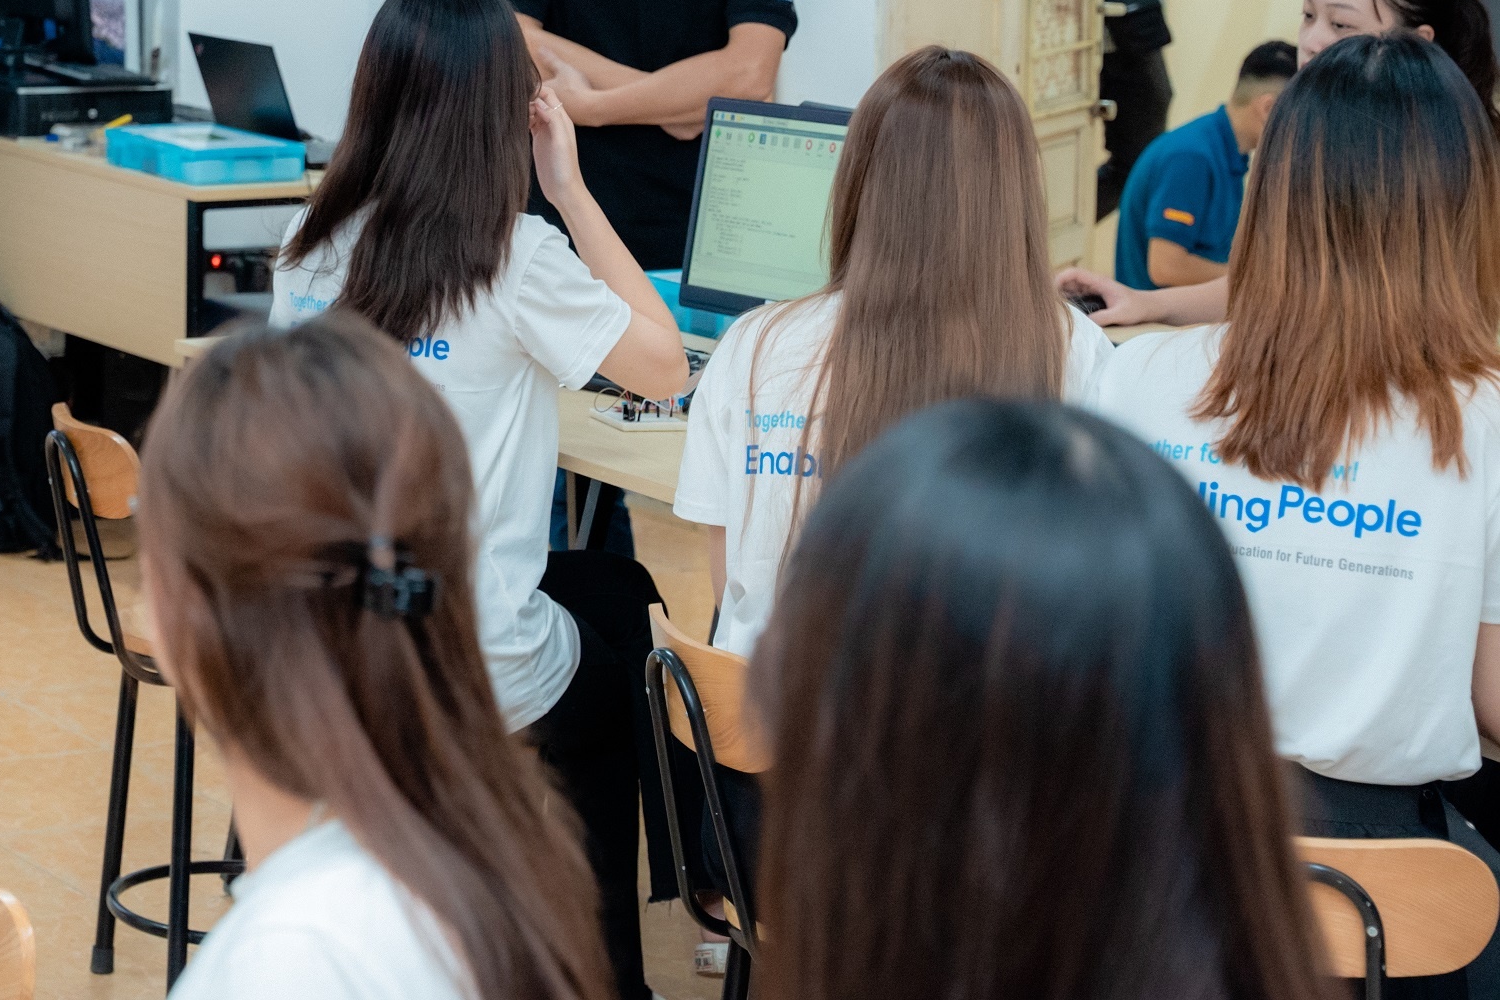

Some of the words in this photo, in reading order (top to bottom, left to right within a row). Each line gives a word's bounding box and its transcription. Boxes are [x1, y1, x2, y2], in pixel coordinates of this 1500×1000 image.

[1277, 485, 1421, 538] People
[1276, 549, 1291, 562] for
[1295, 552, 1333, 569] Future
[1338, 557, 1415, 581] Generations
